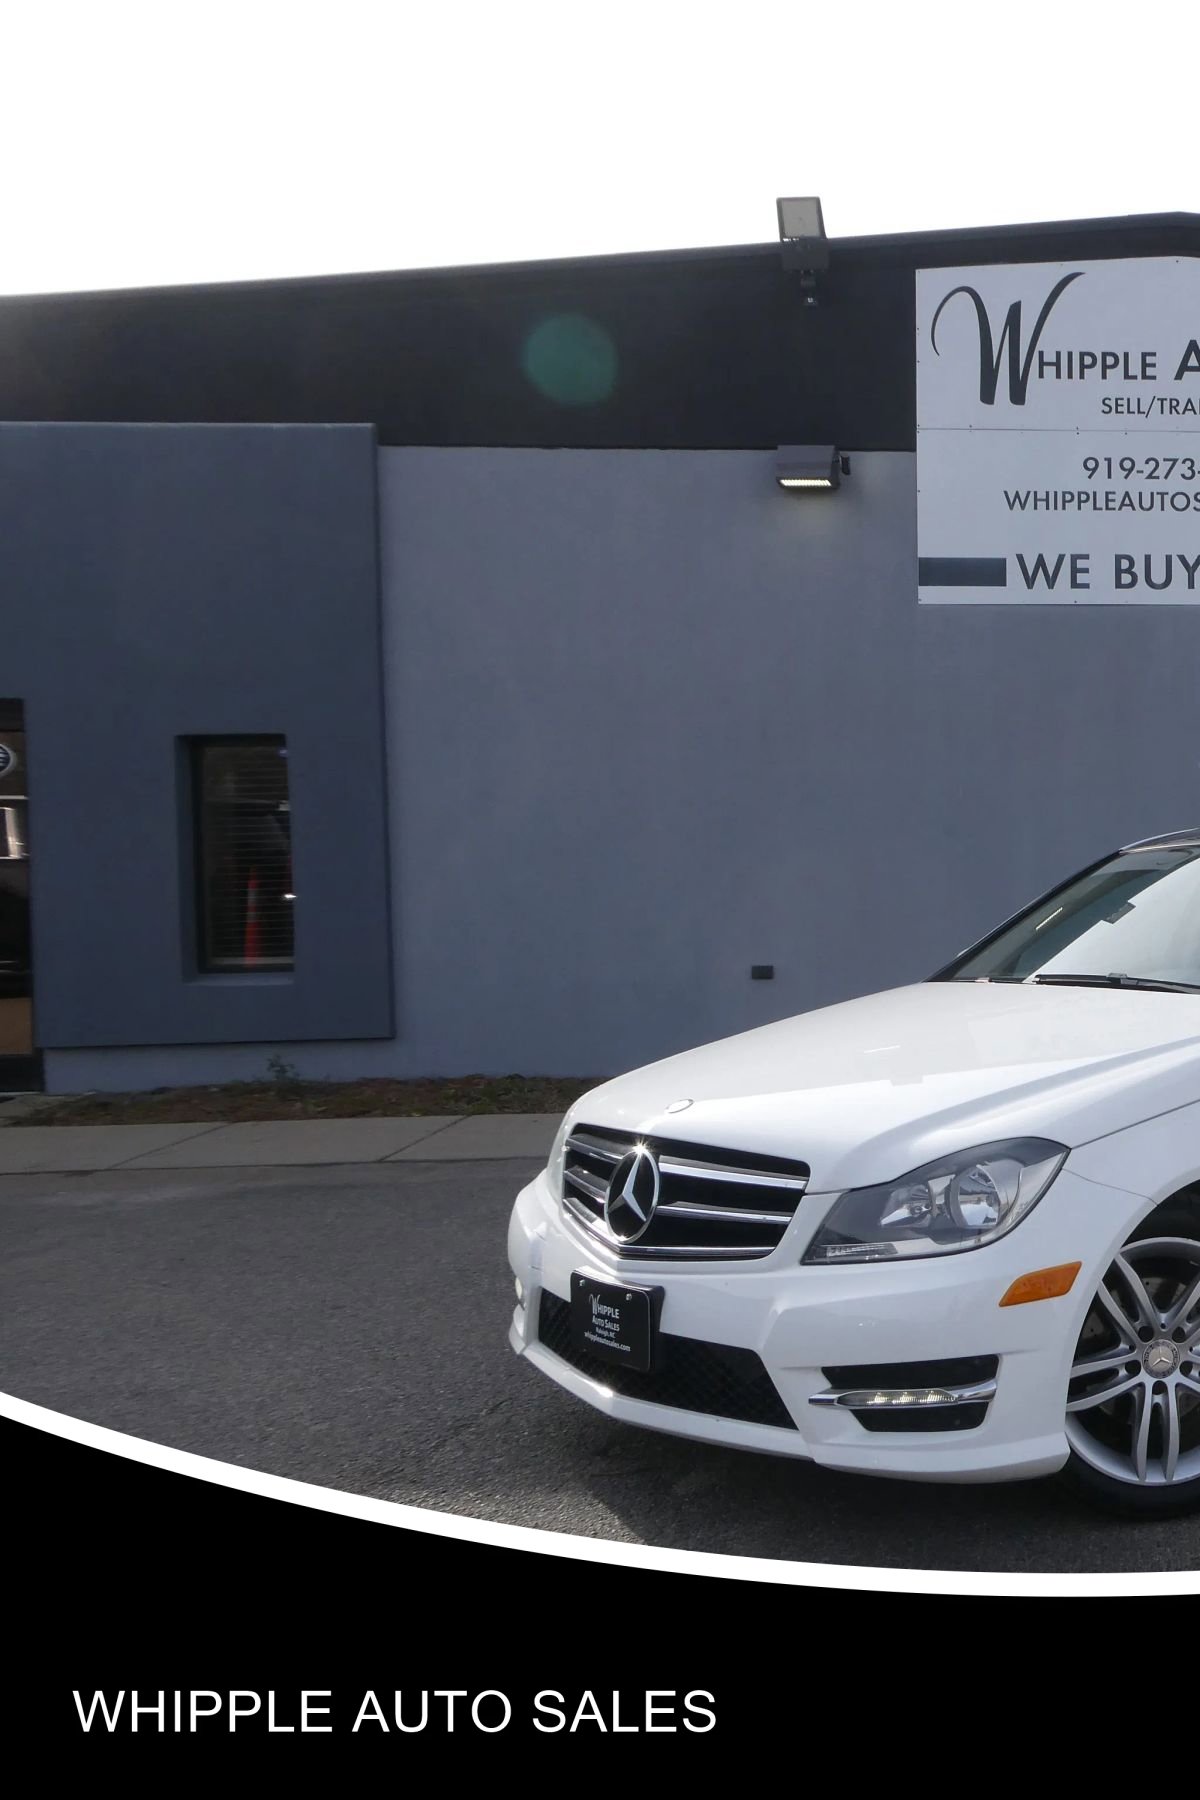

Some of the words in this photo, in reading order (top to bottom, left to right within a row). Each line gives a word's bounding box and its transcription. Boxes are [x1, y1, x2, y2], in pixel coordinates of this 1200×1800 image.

[931, 272, 1157, 405] WHIPPLE
[1016, 553, 1091, 590] WE
[588, 1293, 620, 1318] WHIPPLE
[592, 1314, 605, 1327] AUTO
[604, 1319, 620, 1332] SALES
